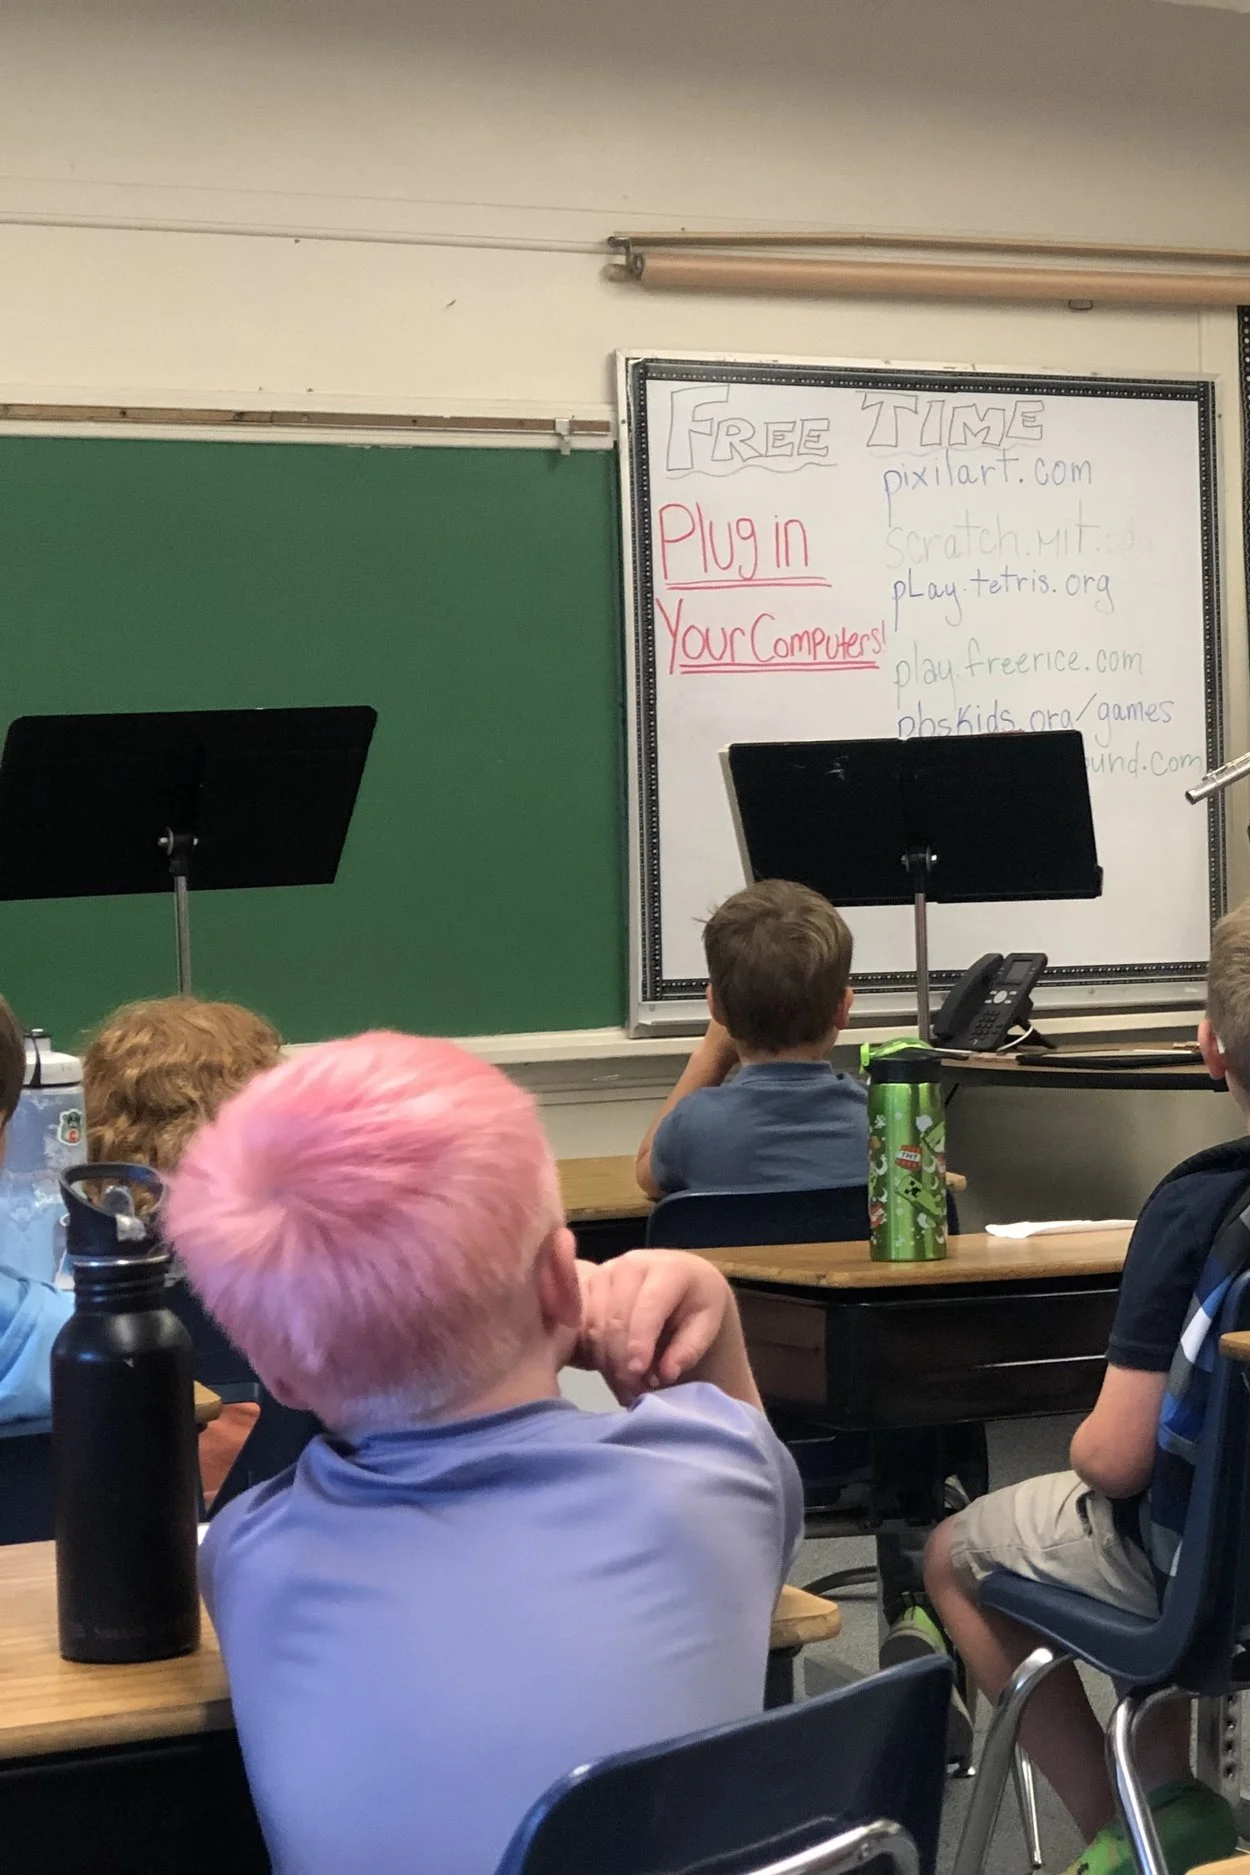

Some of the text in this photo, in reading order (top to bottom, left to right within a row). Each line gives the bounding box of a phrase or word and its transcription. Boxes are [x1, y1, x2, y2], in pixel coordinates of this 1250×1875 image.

[666, 383, 1045, 471] FREE TIME
[659, 501, 809, 581] Plug in
[655, 598, 887, 675] Your Computers!
[893, 637, 1144, 710] play.freerice.com
